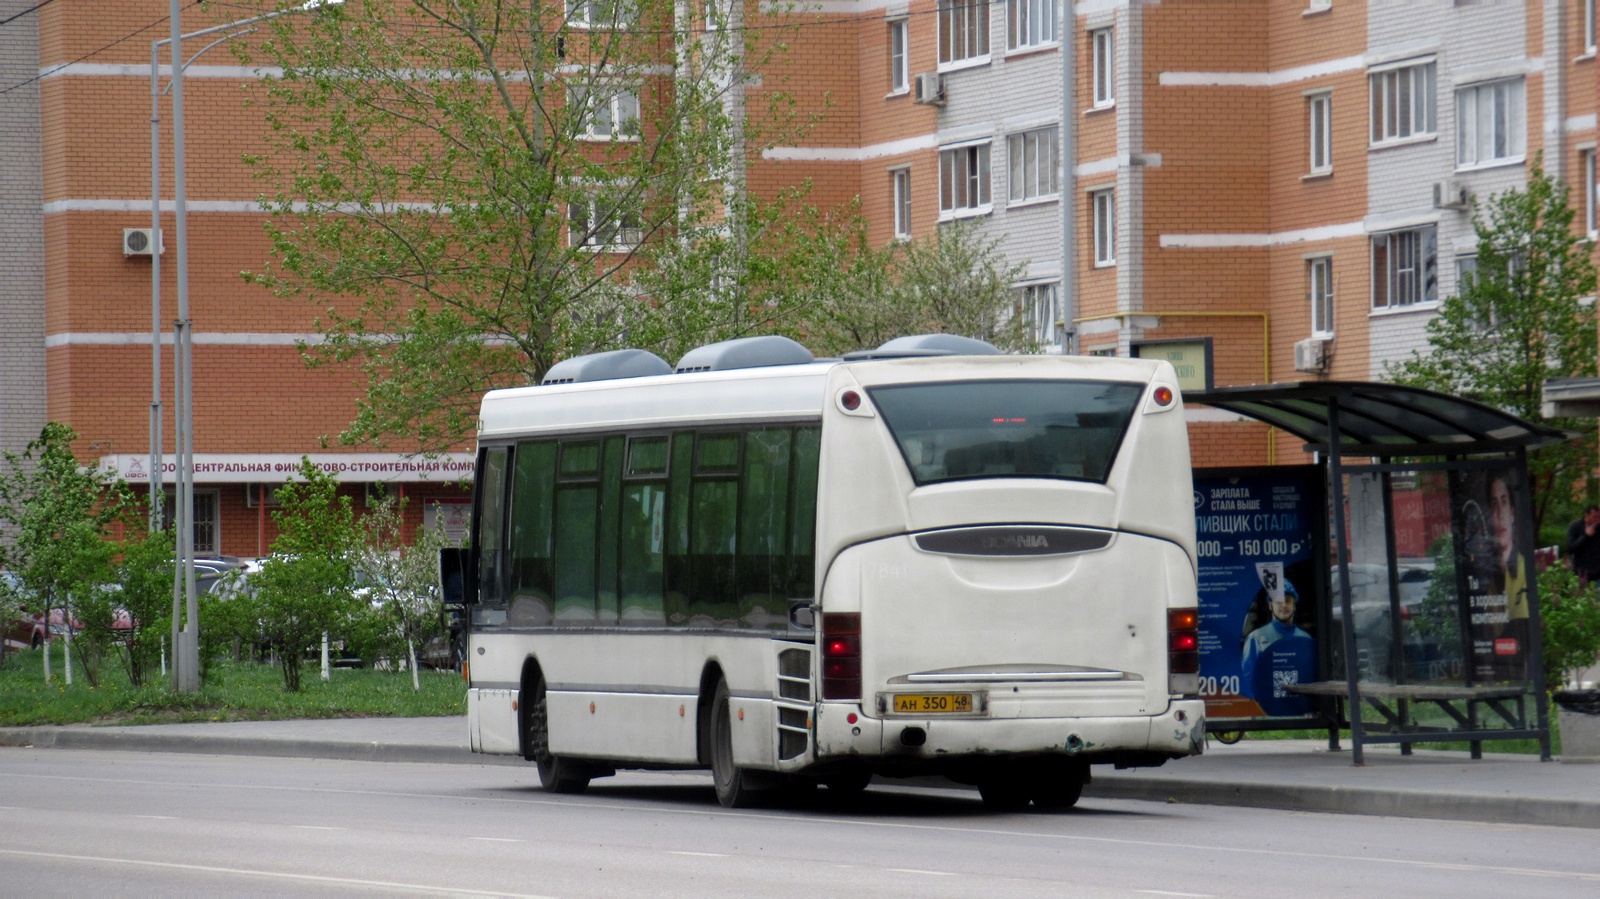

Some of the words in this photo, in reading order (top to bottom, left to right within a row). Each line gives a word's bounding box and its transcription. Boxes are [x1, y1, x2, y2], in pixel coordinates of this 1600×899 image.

[1210, 487, 1250, 499] ЗАРПЛАТА
[1211, 500, 1236, 511] СТАЛА
[1236, 499, 1261, 510] ВЫШЕ
[1254, 513, 1298, 531] СТАЛИ
[1197, 540, 1221, 557] 000
[1238, 539, 1260, 556] 150
[1263, 538, 1288, 555] 000
[1198, 676, 1218, 696] 20
[1220, 675, 1240, 696] 20
[922, 697, 947, 710] 350
[955, 696, 967, 706] 48
